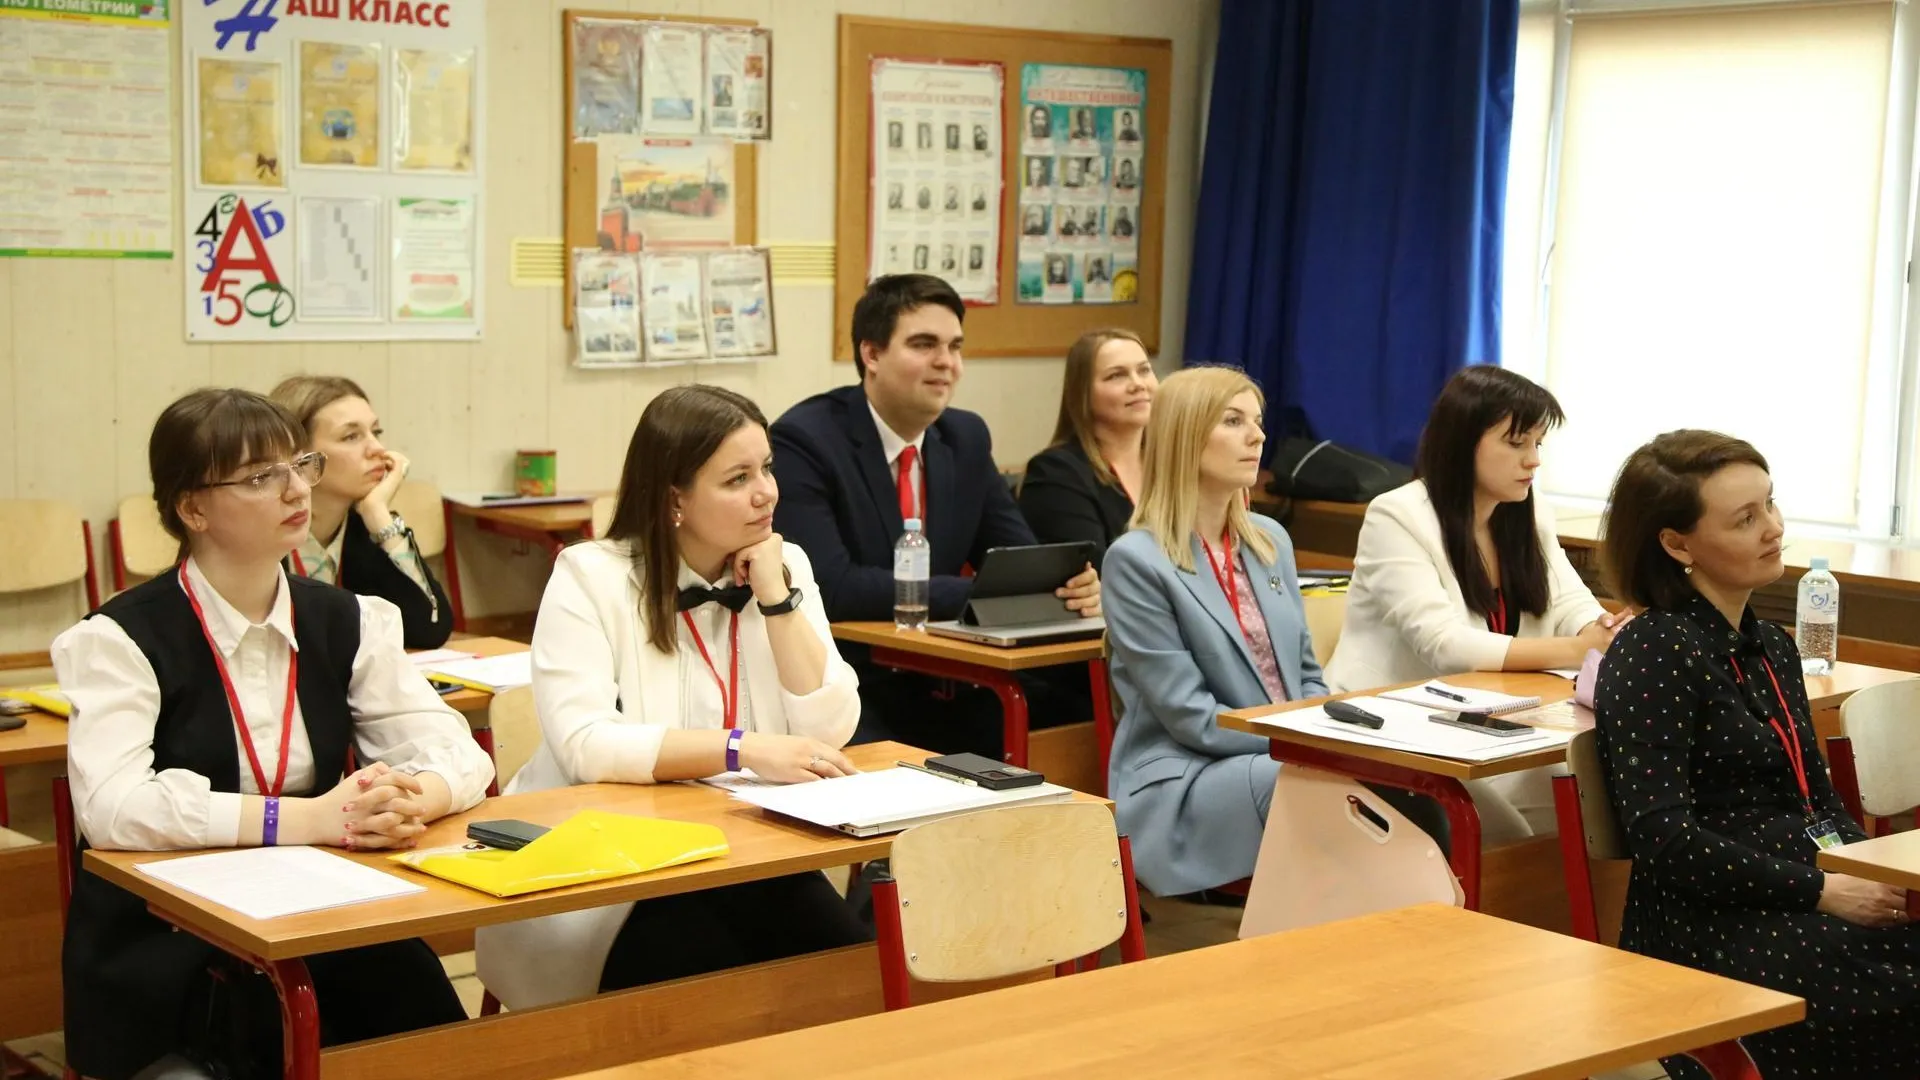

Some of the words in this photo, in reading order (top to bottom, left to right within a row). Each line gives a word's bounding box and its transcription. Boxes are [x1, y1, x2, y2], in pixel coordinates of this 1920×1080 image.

[348, 0, 451, 28] КЛАСС
[194, 203, 222, 242] 4
[251, 200, 286, 239] Б
[214, 278, 244, 327] 5
